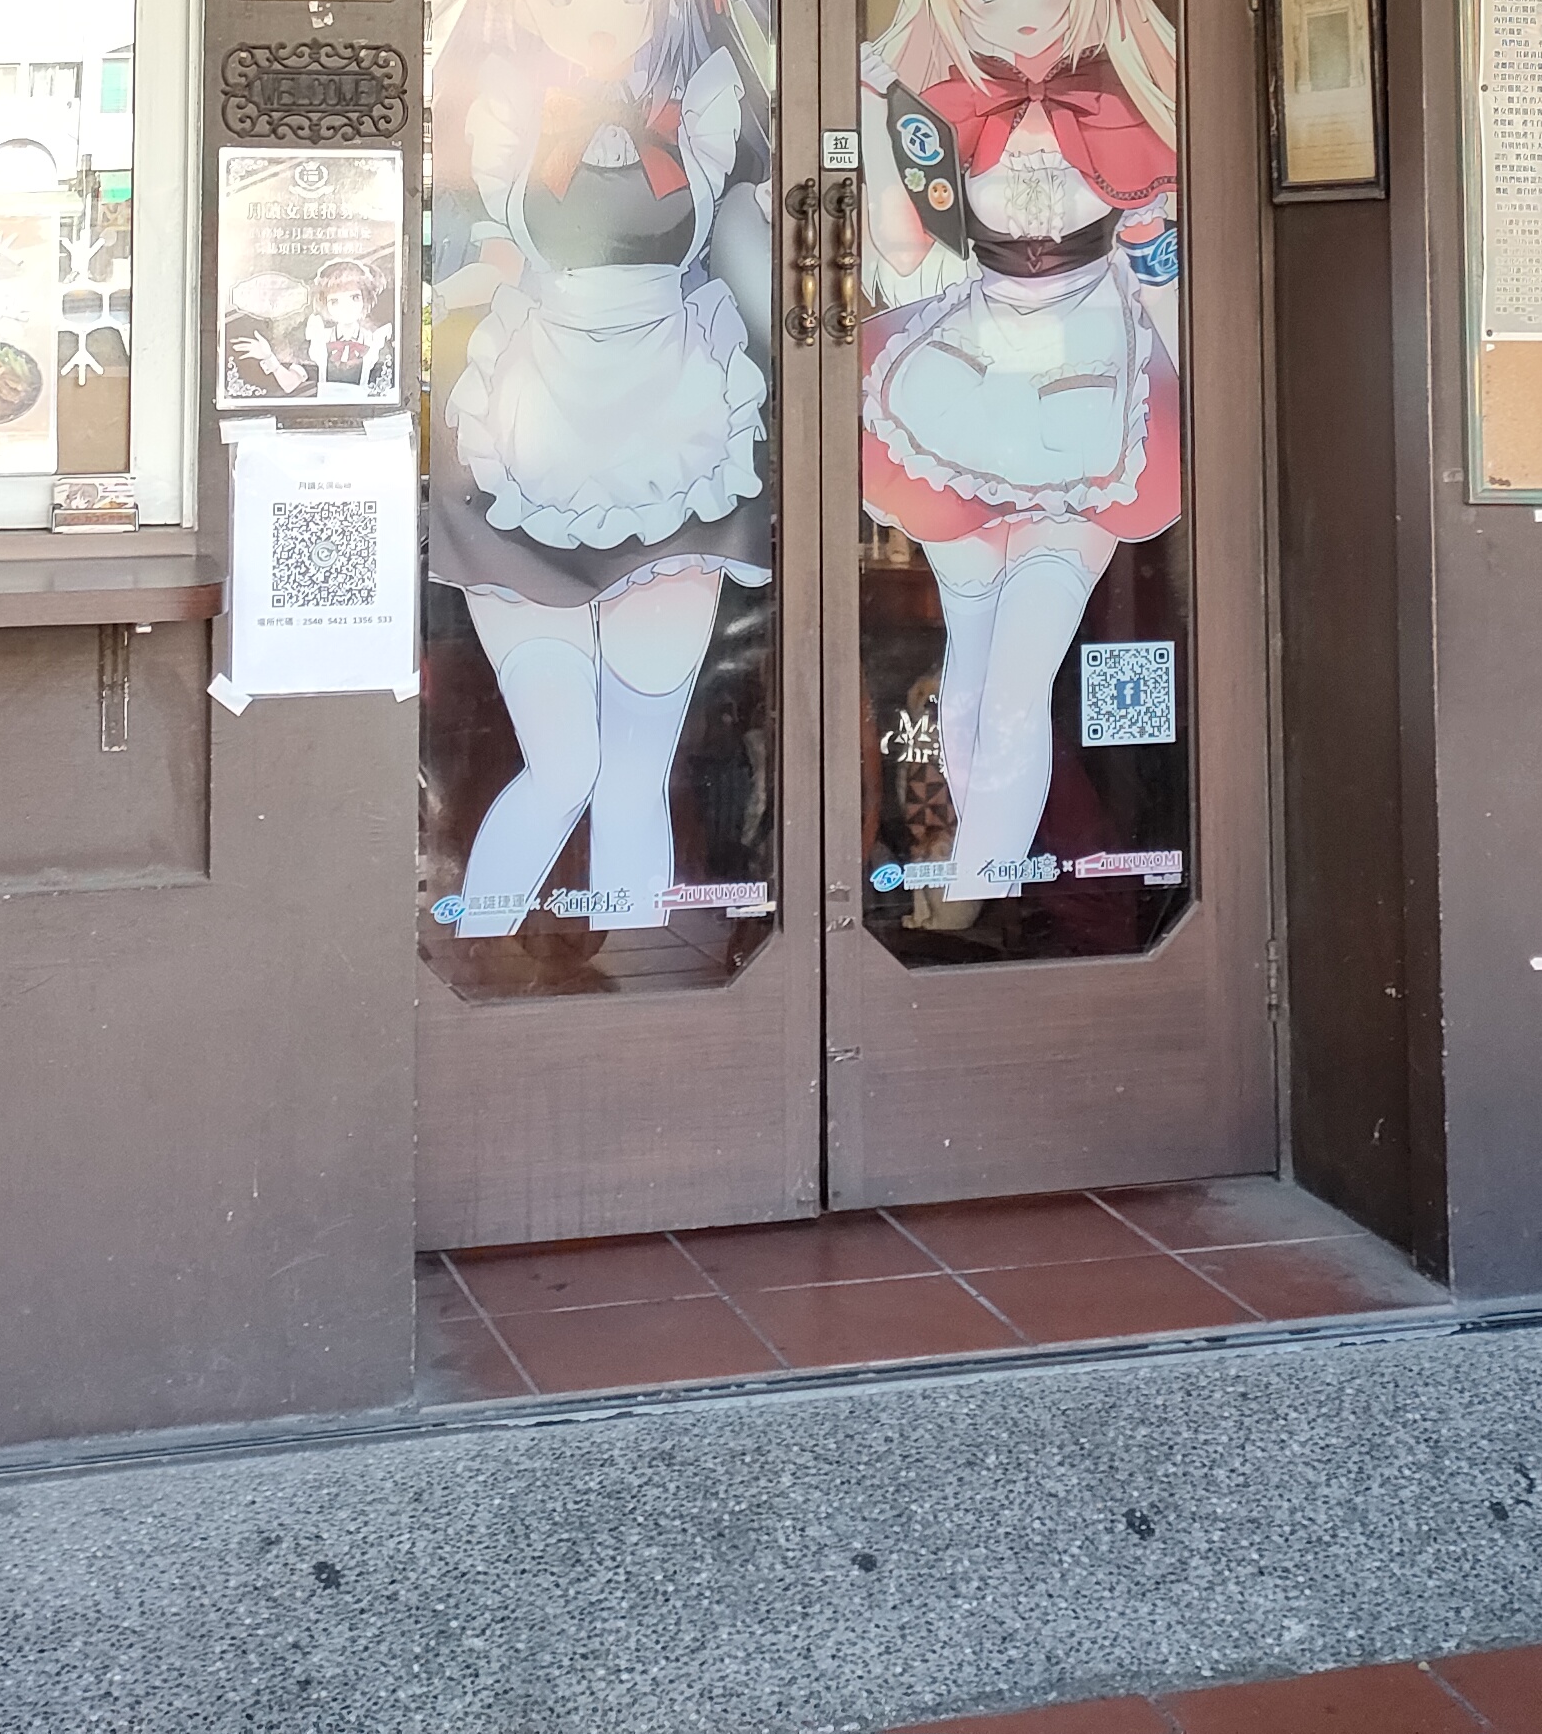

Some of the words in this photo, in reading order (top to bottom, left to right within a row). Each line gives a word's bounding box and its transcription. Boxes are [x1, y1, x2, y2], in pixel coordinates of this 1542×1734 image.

[262, 74, 371, 107] WELCOME
[832, 135, 850, 151] 拉
[829, 155, 853, 165] PULL
